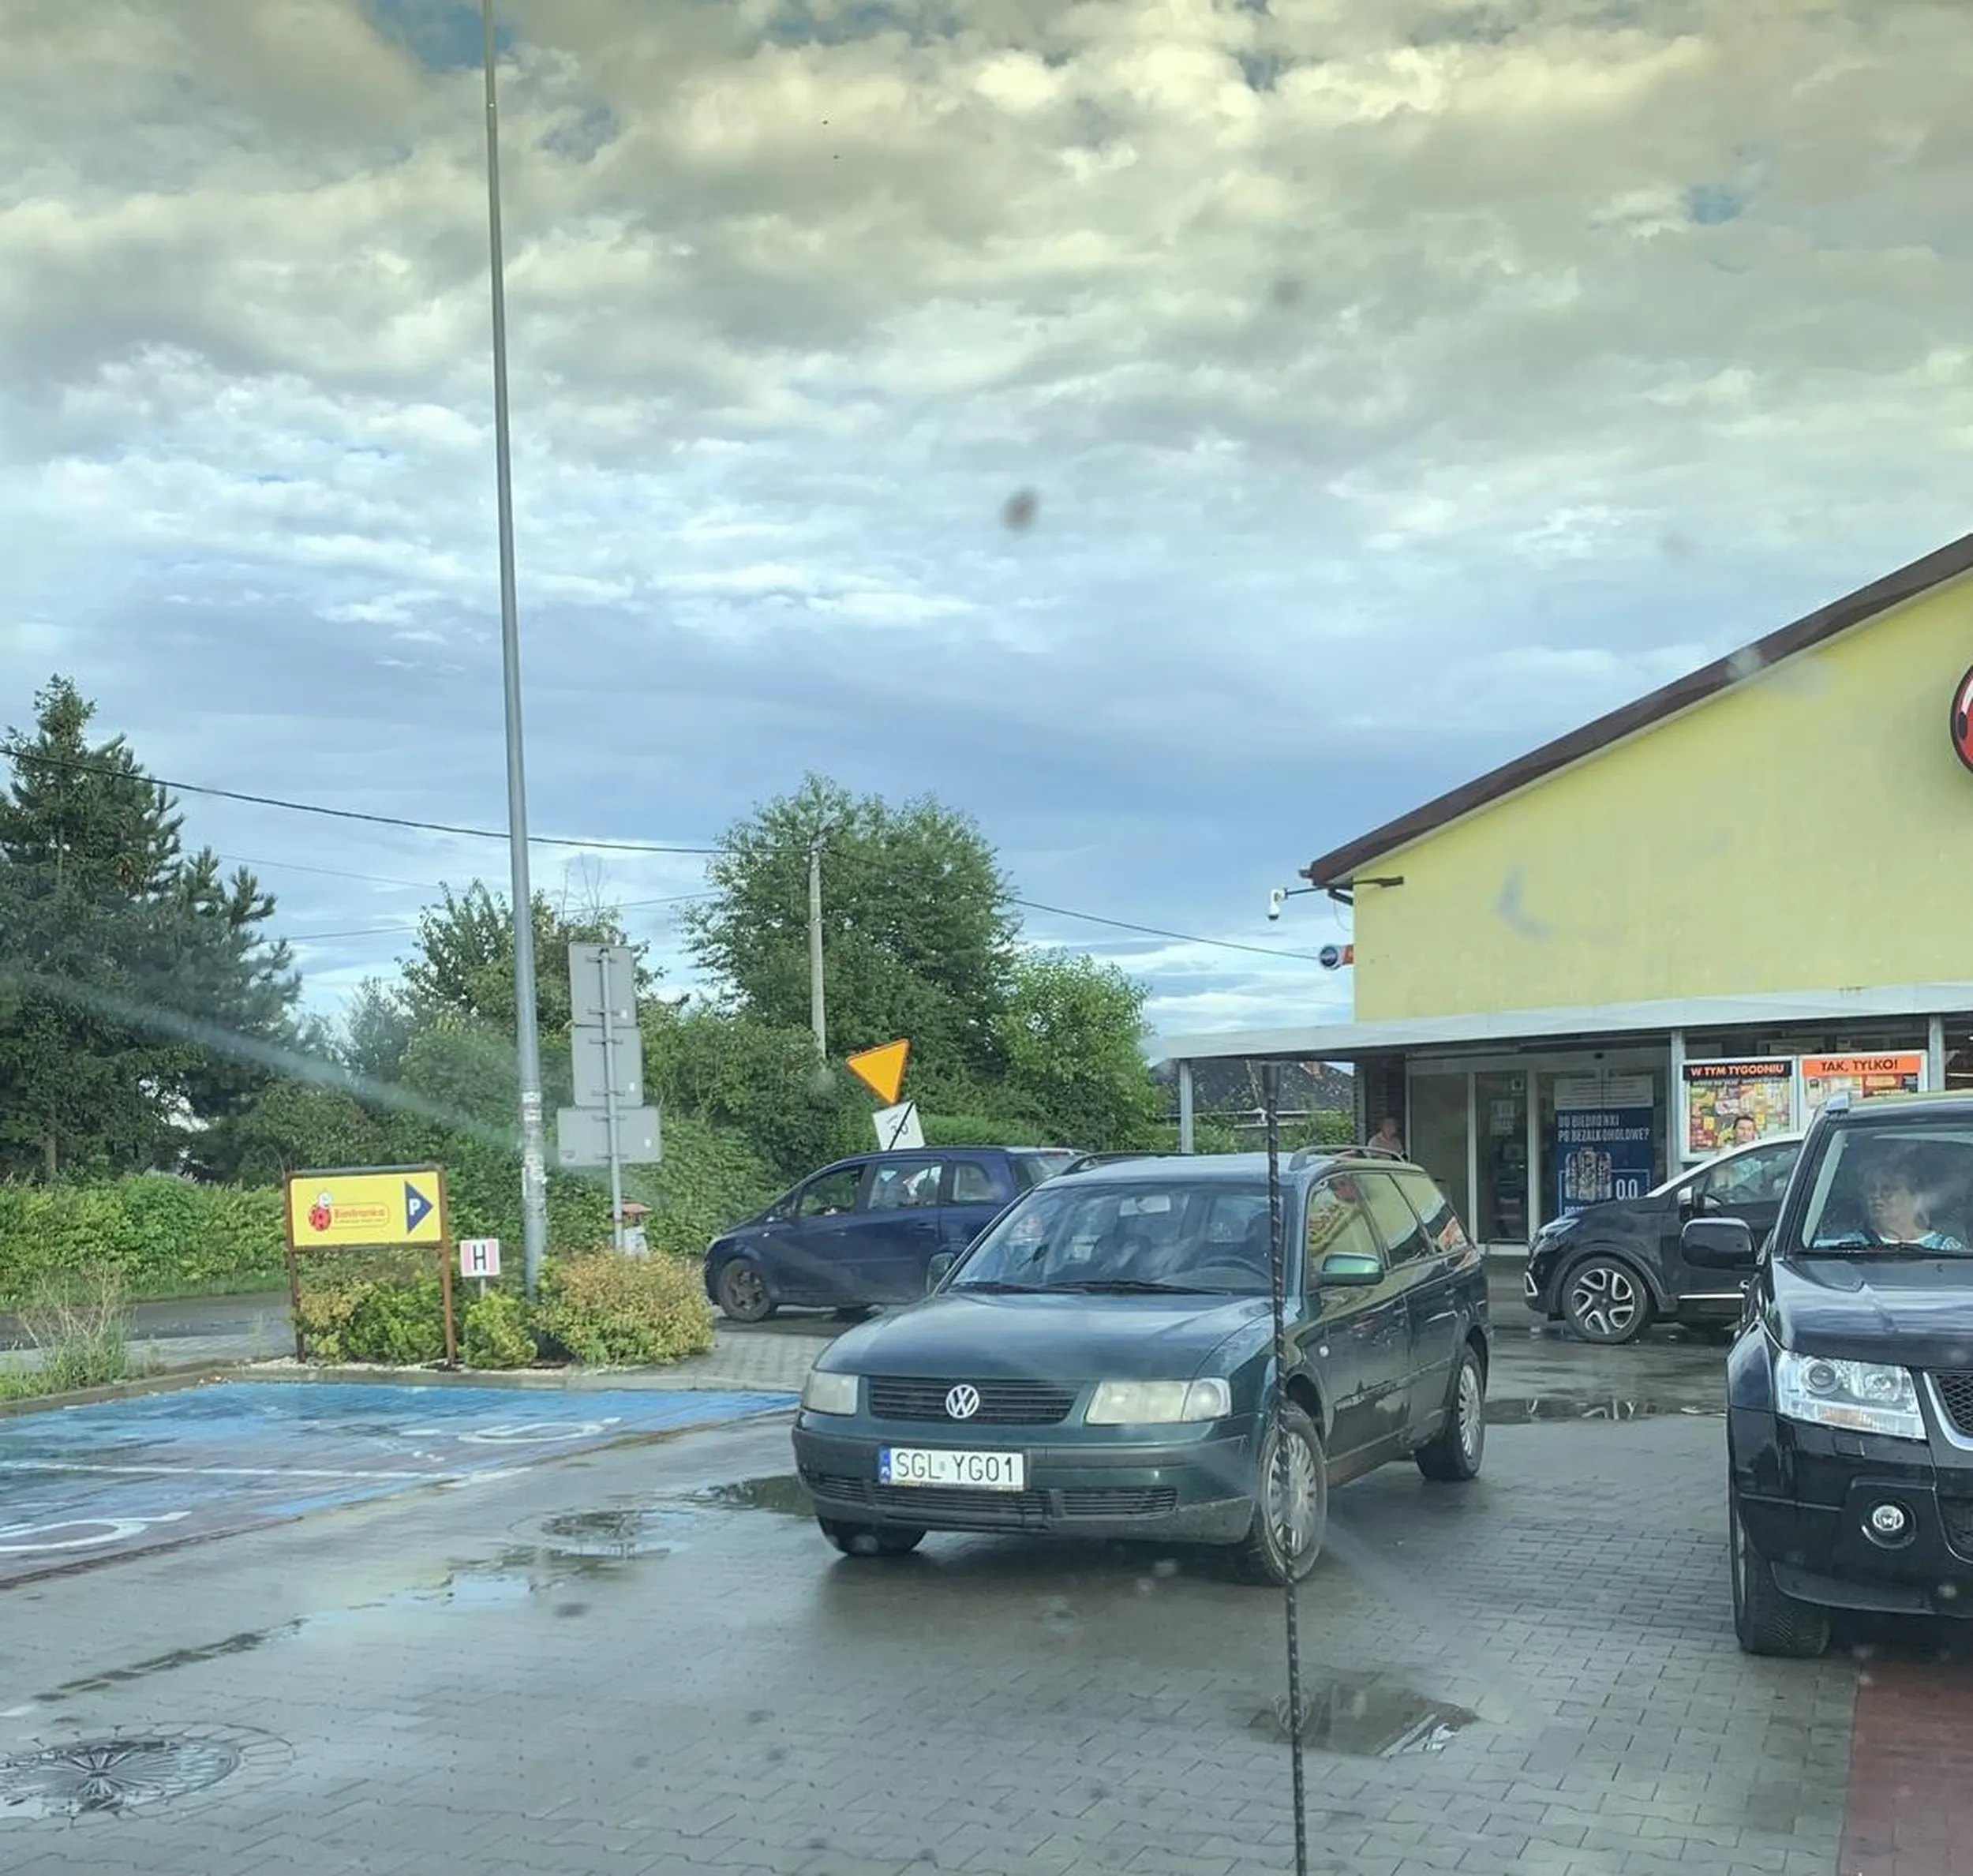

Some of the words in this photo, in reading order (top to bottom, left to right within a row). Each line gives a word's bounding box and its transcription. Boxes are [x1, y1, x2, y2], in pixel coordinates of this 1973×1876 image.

[1690, 1067, 1702, 1077] W
[1705, 1066, 1726, 1077] TYM
[1728, 1063, 1784, 1076] TYGODNIU
[1820, 1061, 1848, 1072] TAK,
[1853, 1058, 1898, 1071] TYLKO!
[1557, 1129, 1570, 1143] PO
[408, 1198, 421, 1217] P
[473, 1244, 487, 1271] H
[896, 1452, 942, 1480] SGL
